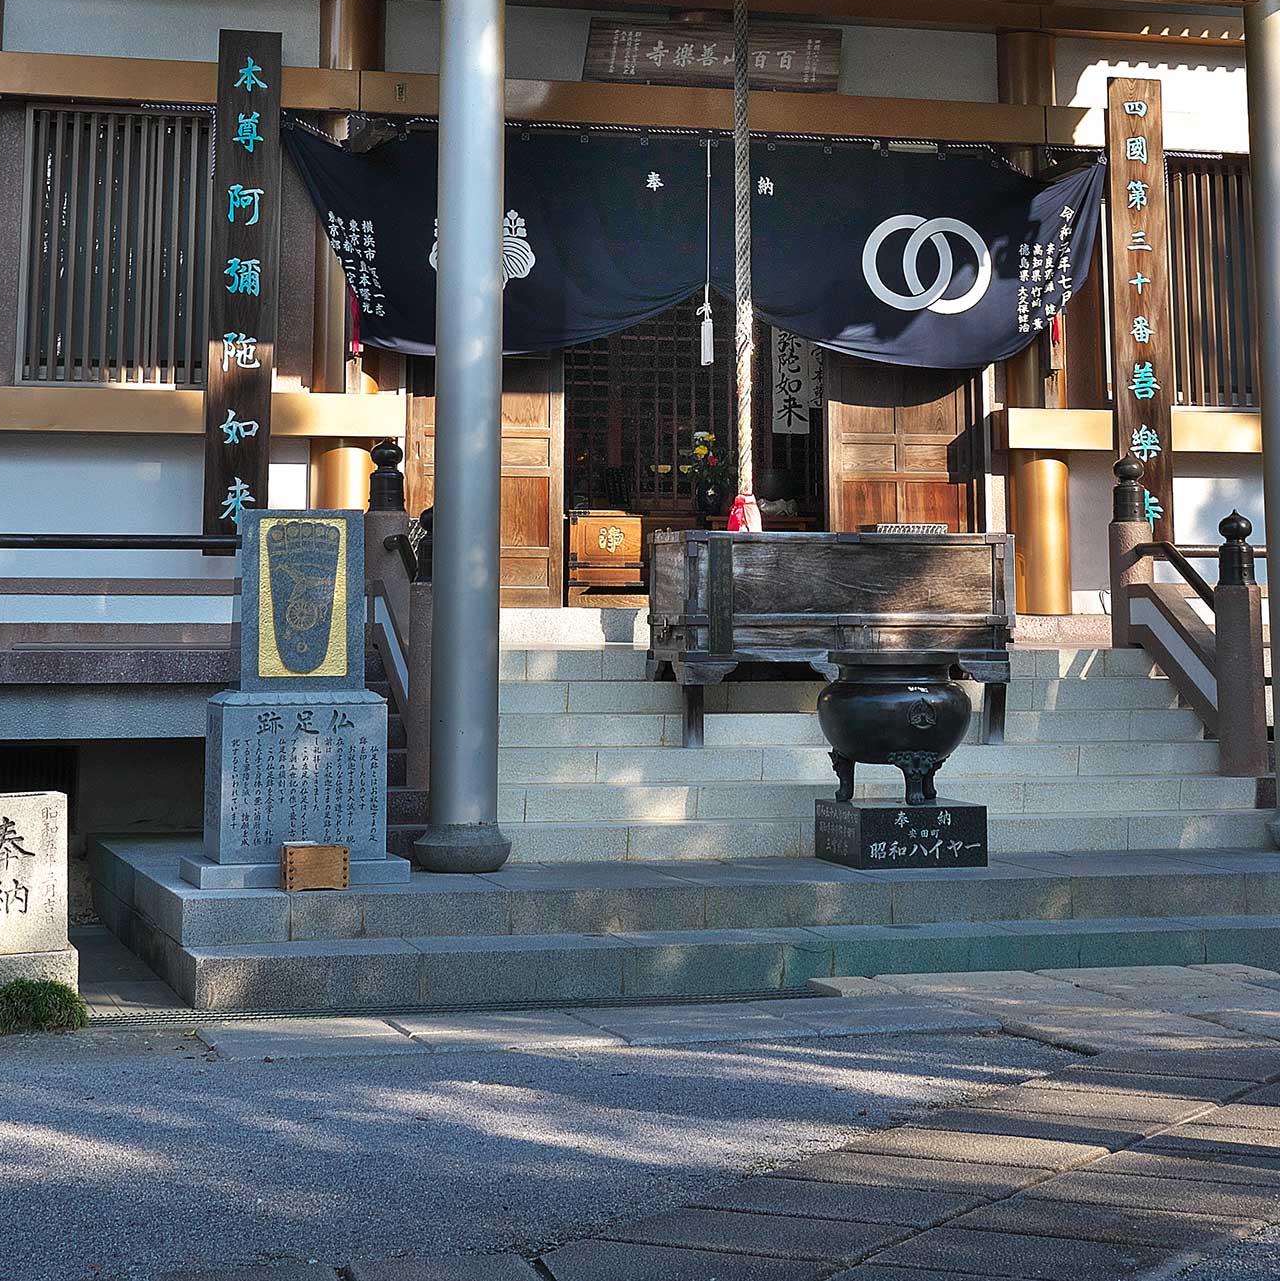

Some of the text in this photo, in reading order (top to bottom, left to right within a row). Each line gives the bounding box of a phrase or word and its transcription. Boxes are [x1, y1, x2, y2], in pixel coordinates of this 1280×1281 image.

[646, 171, 774, 196] 奉 納
[894, 810, 952, 828] 奉納
[870, 839, 982, 860] 昭和ハイヤー
